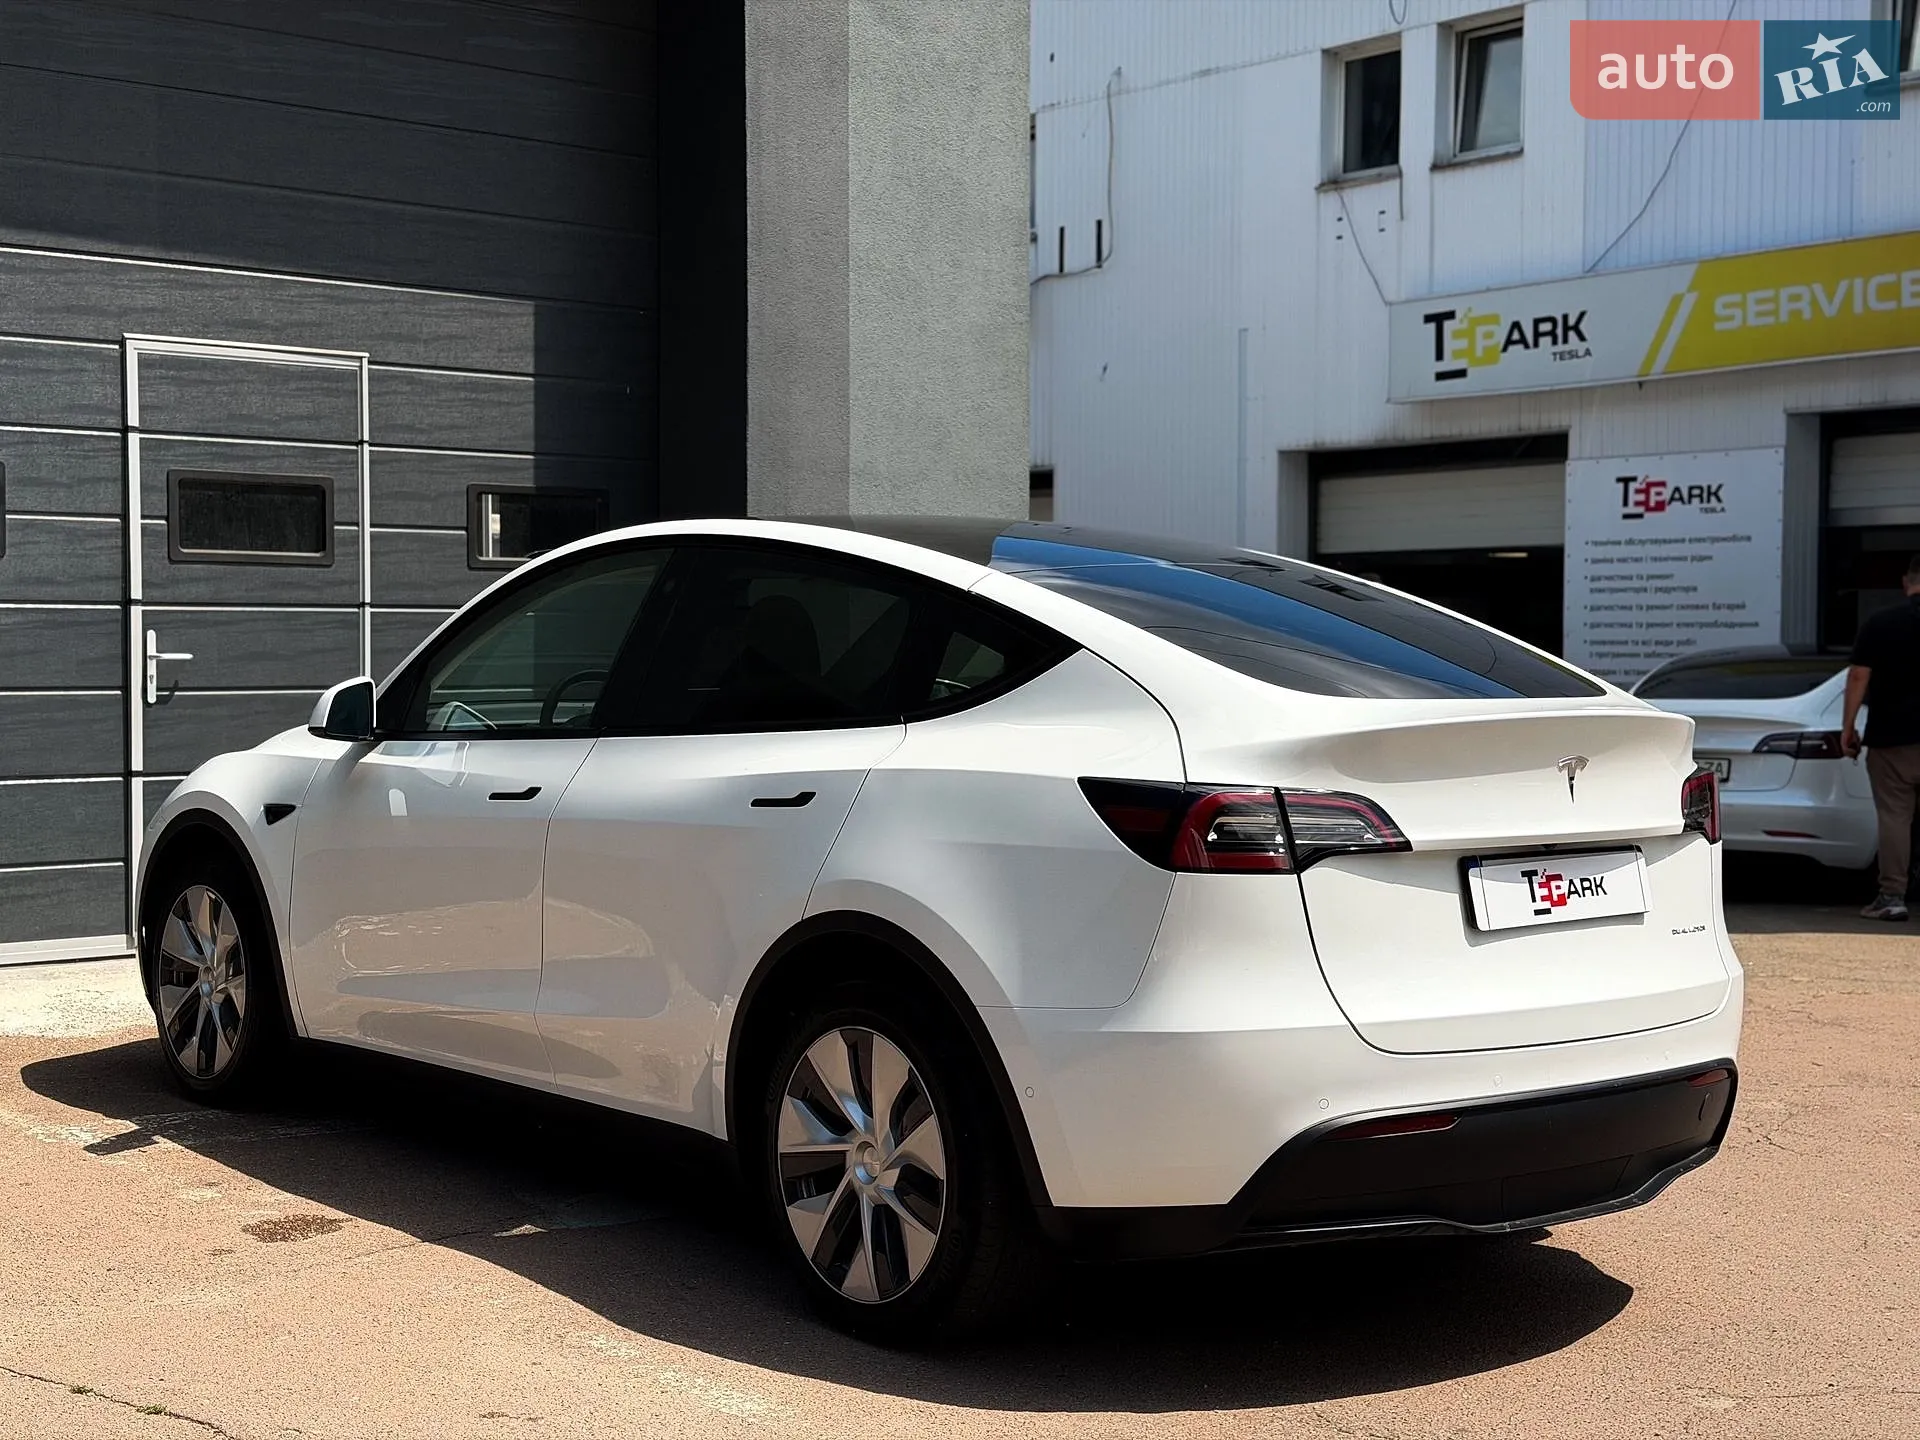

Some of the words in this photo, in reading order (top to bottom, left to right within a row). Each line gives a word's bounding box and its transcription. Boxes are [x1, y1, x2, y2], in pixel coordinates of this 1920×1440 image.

[1713, 269, 1920, 332] SERVICE
[1552, 348, 1592, 361] TESLA
[1699, 506, 1726, 514] TESLA
[1521, 869, 1607, 908] TEPARK
